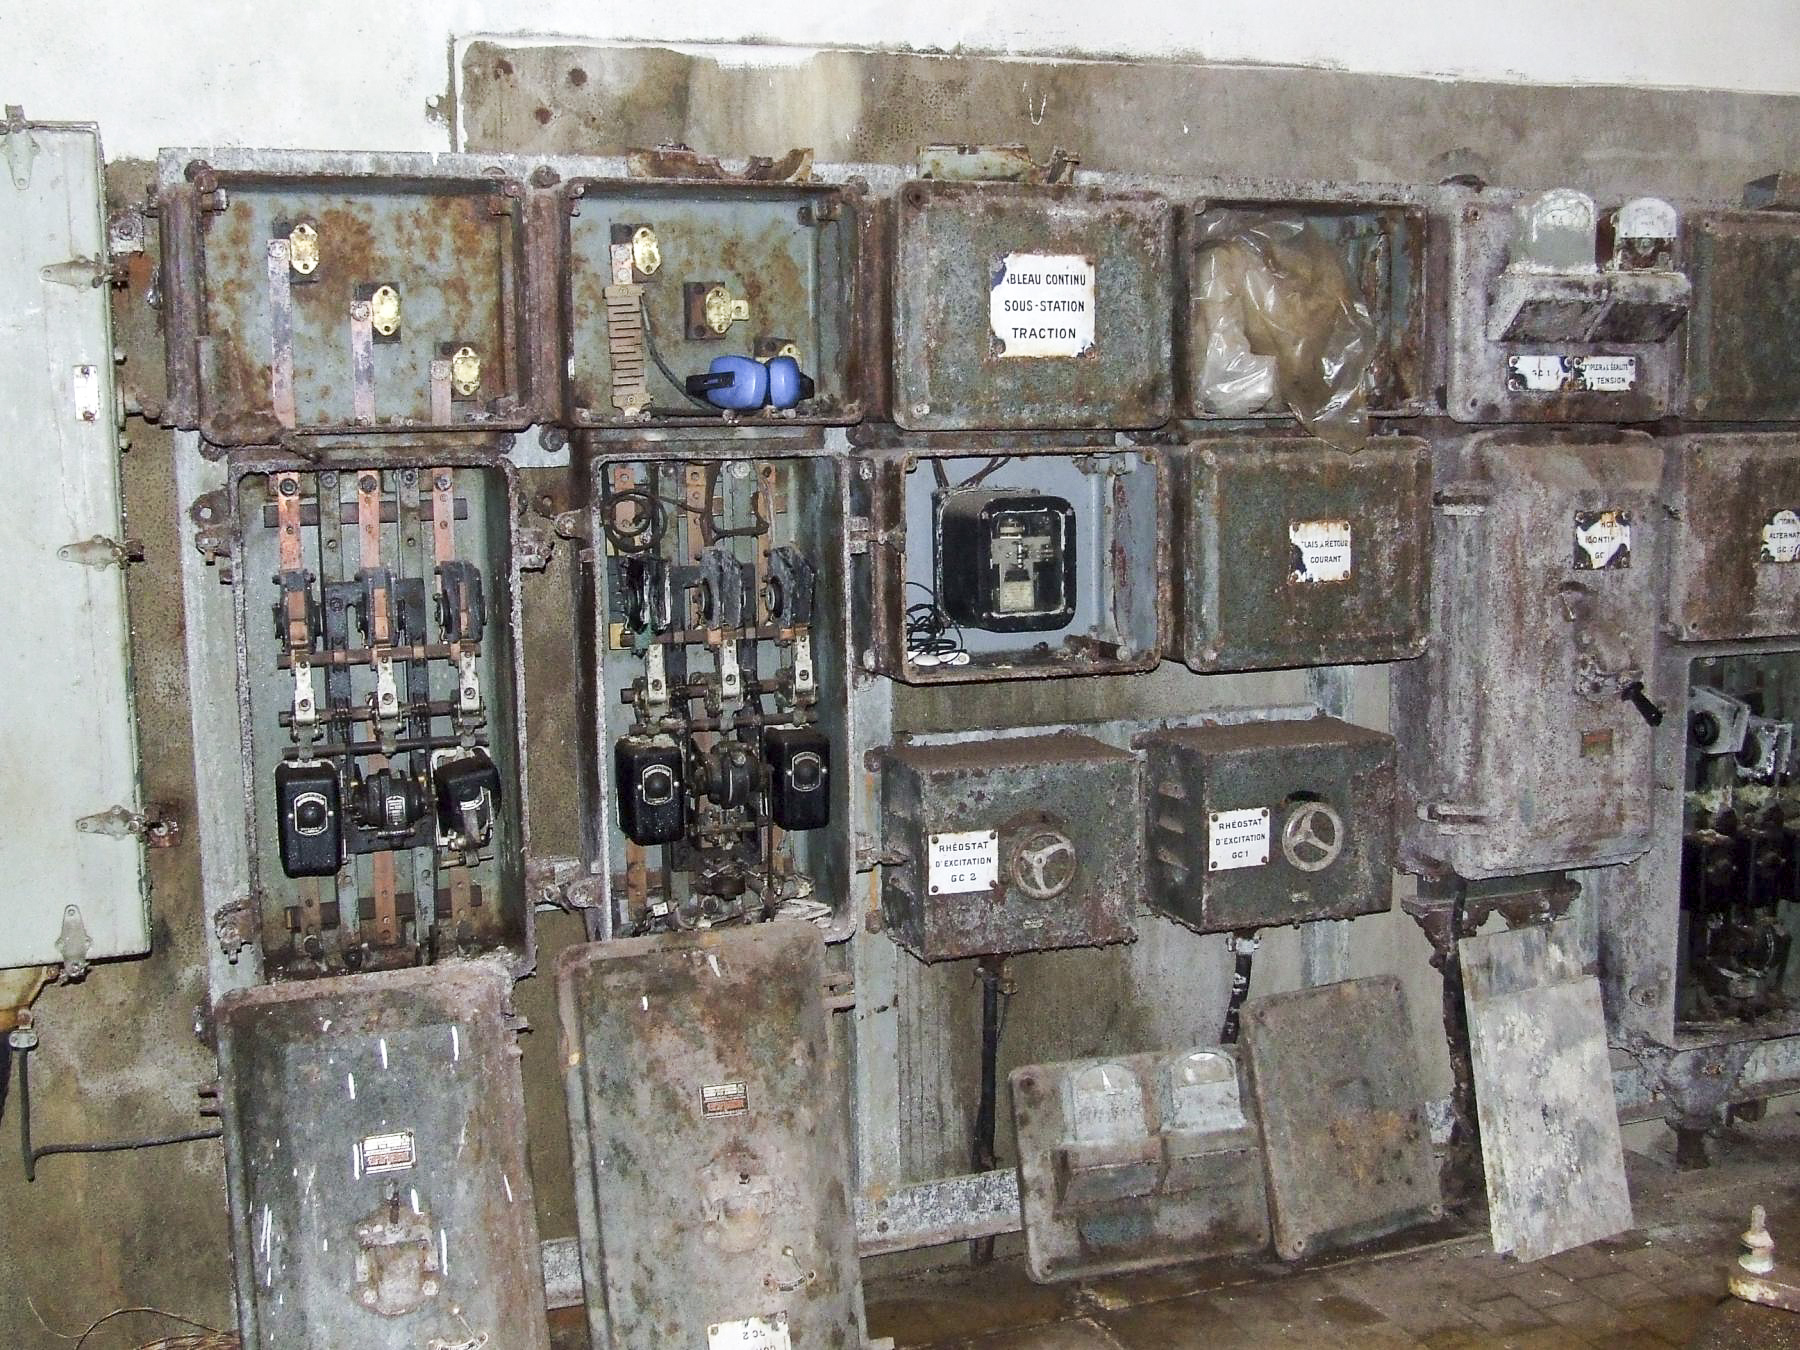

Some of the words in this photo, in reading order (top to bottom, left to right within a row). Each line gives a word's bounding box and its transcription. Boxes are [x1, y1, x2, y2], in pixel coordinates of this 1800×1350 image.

[1046, 274, 1086, 286] CONTINU
[1012, 327, 1076, 339] TRACTION
[1310, 555, 1342, 564] COURANT
[1219, 818, 1262, 830] RHÉOSTAT
[939, 841, 989, 852] RHÉOSTAT
[1231, 851, 1243, 859] GC
[951, 874, 965, 883] GC
[969, 872, 977, 881] 2
